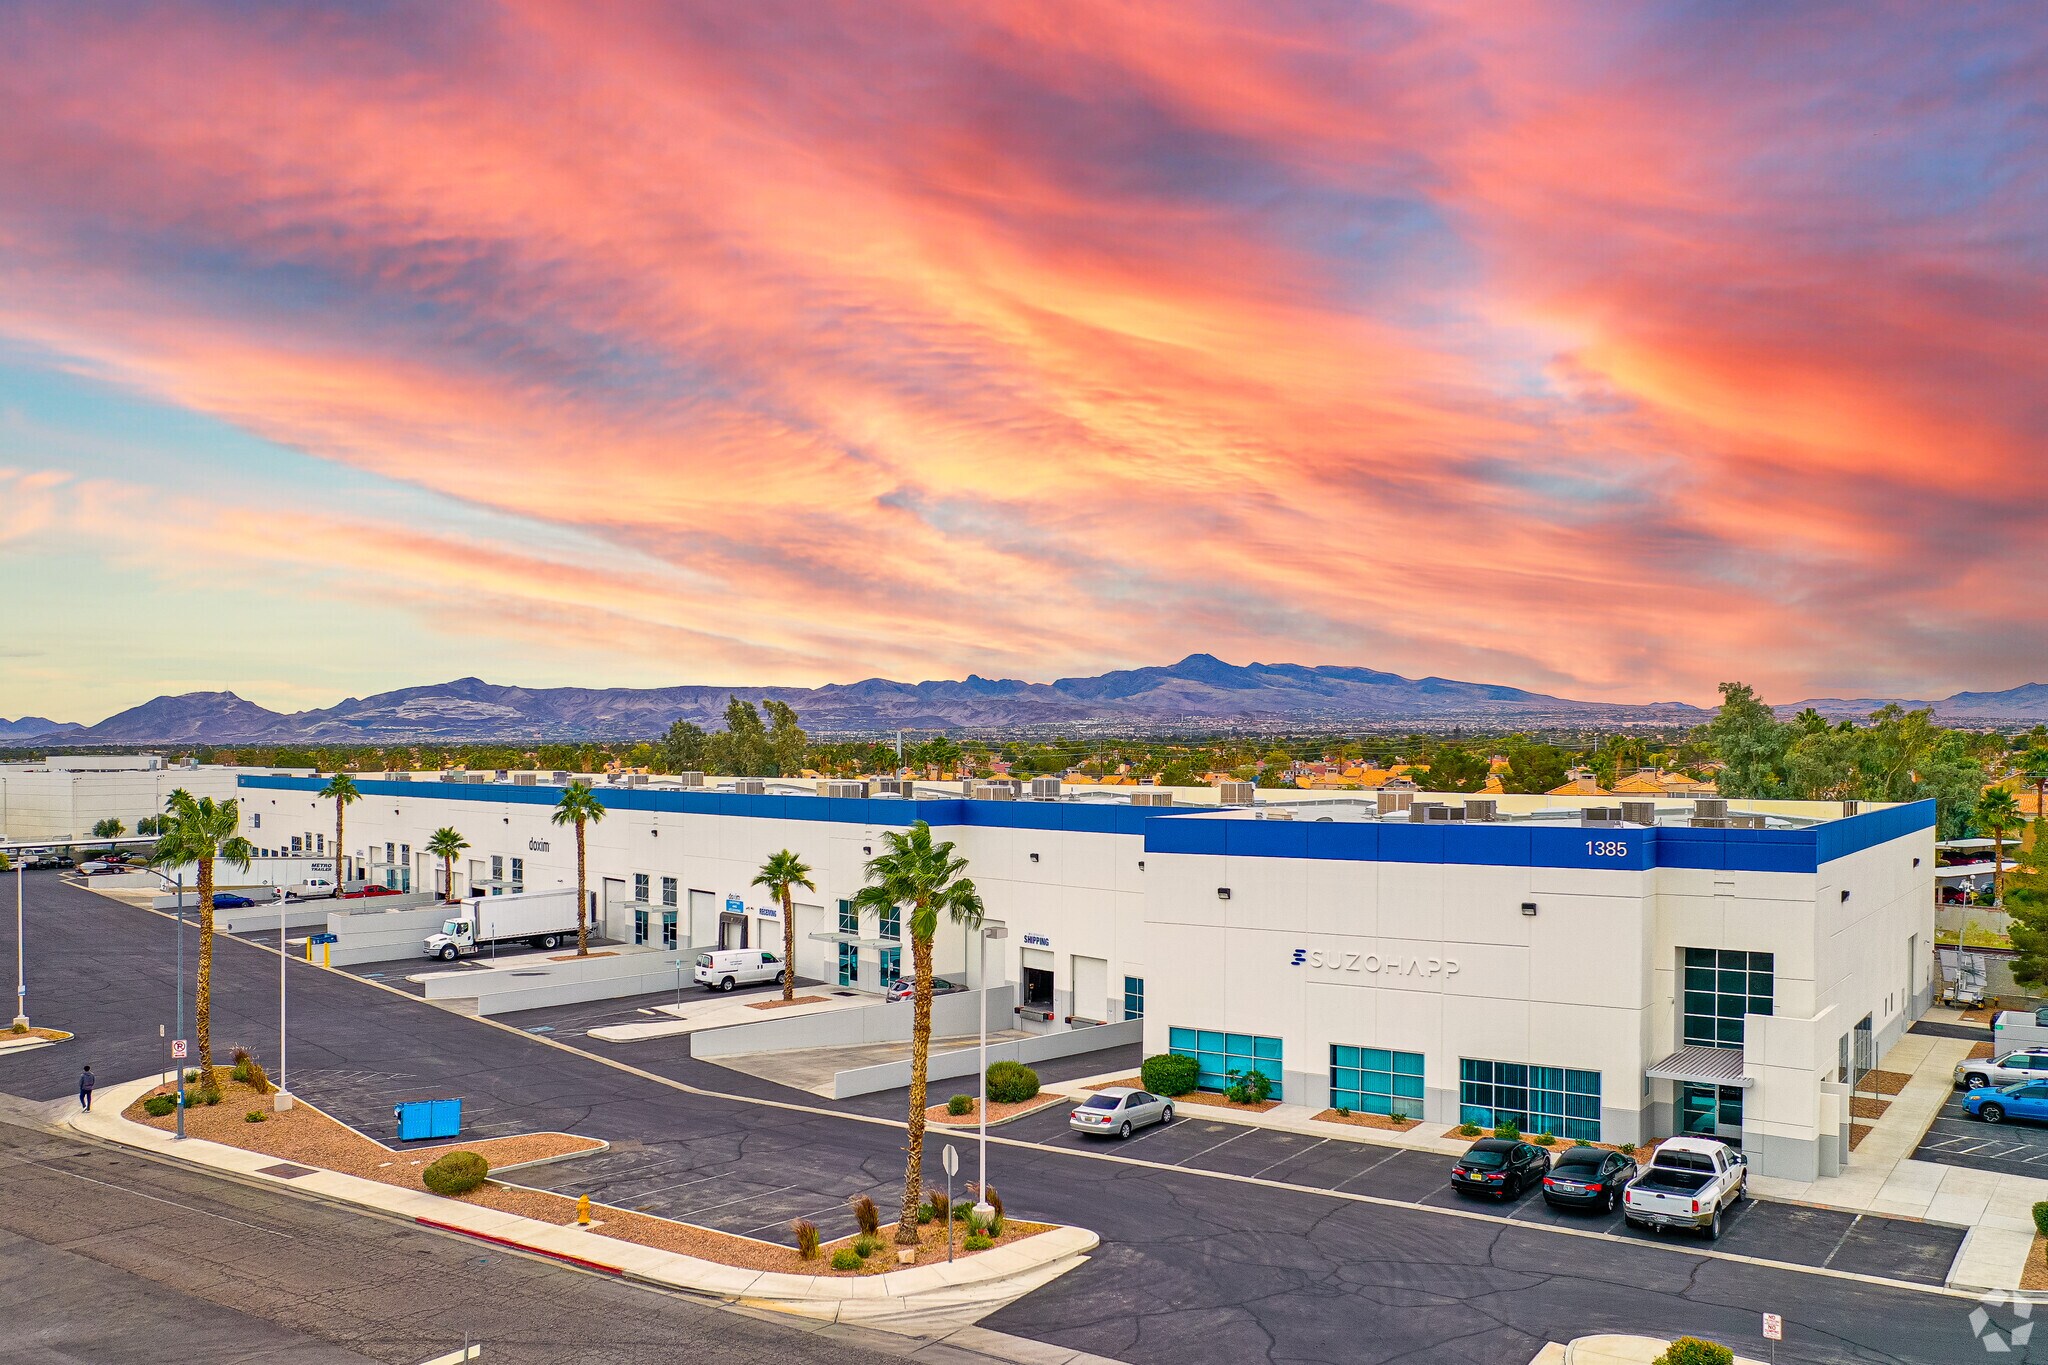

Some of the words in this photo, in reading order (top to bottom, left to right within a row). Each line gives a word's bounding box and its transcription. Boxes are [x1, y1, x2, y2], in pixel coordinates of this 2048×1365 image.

[529, 836, 550, 852] doxim
[1585, 840, 1627, 857] 1385
[1023, 935, 1049, 946] SHIPPING
[1310, 951, 1460, 979] SUZOHAPP
